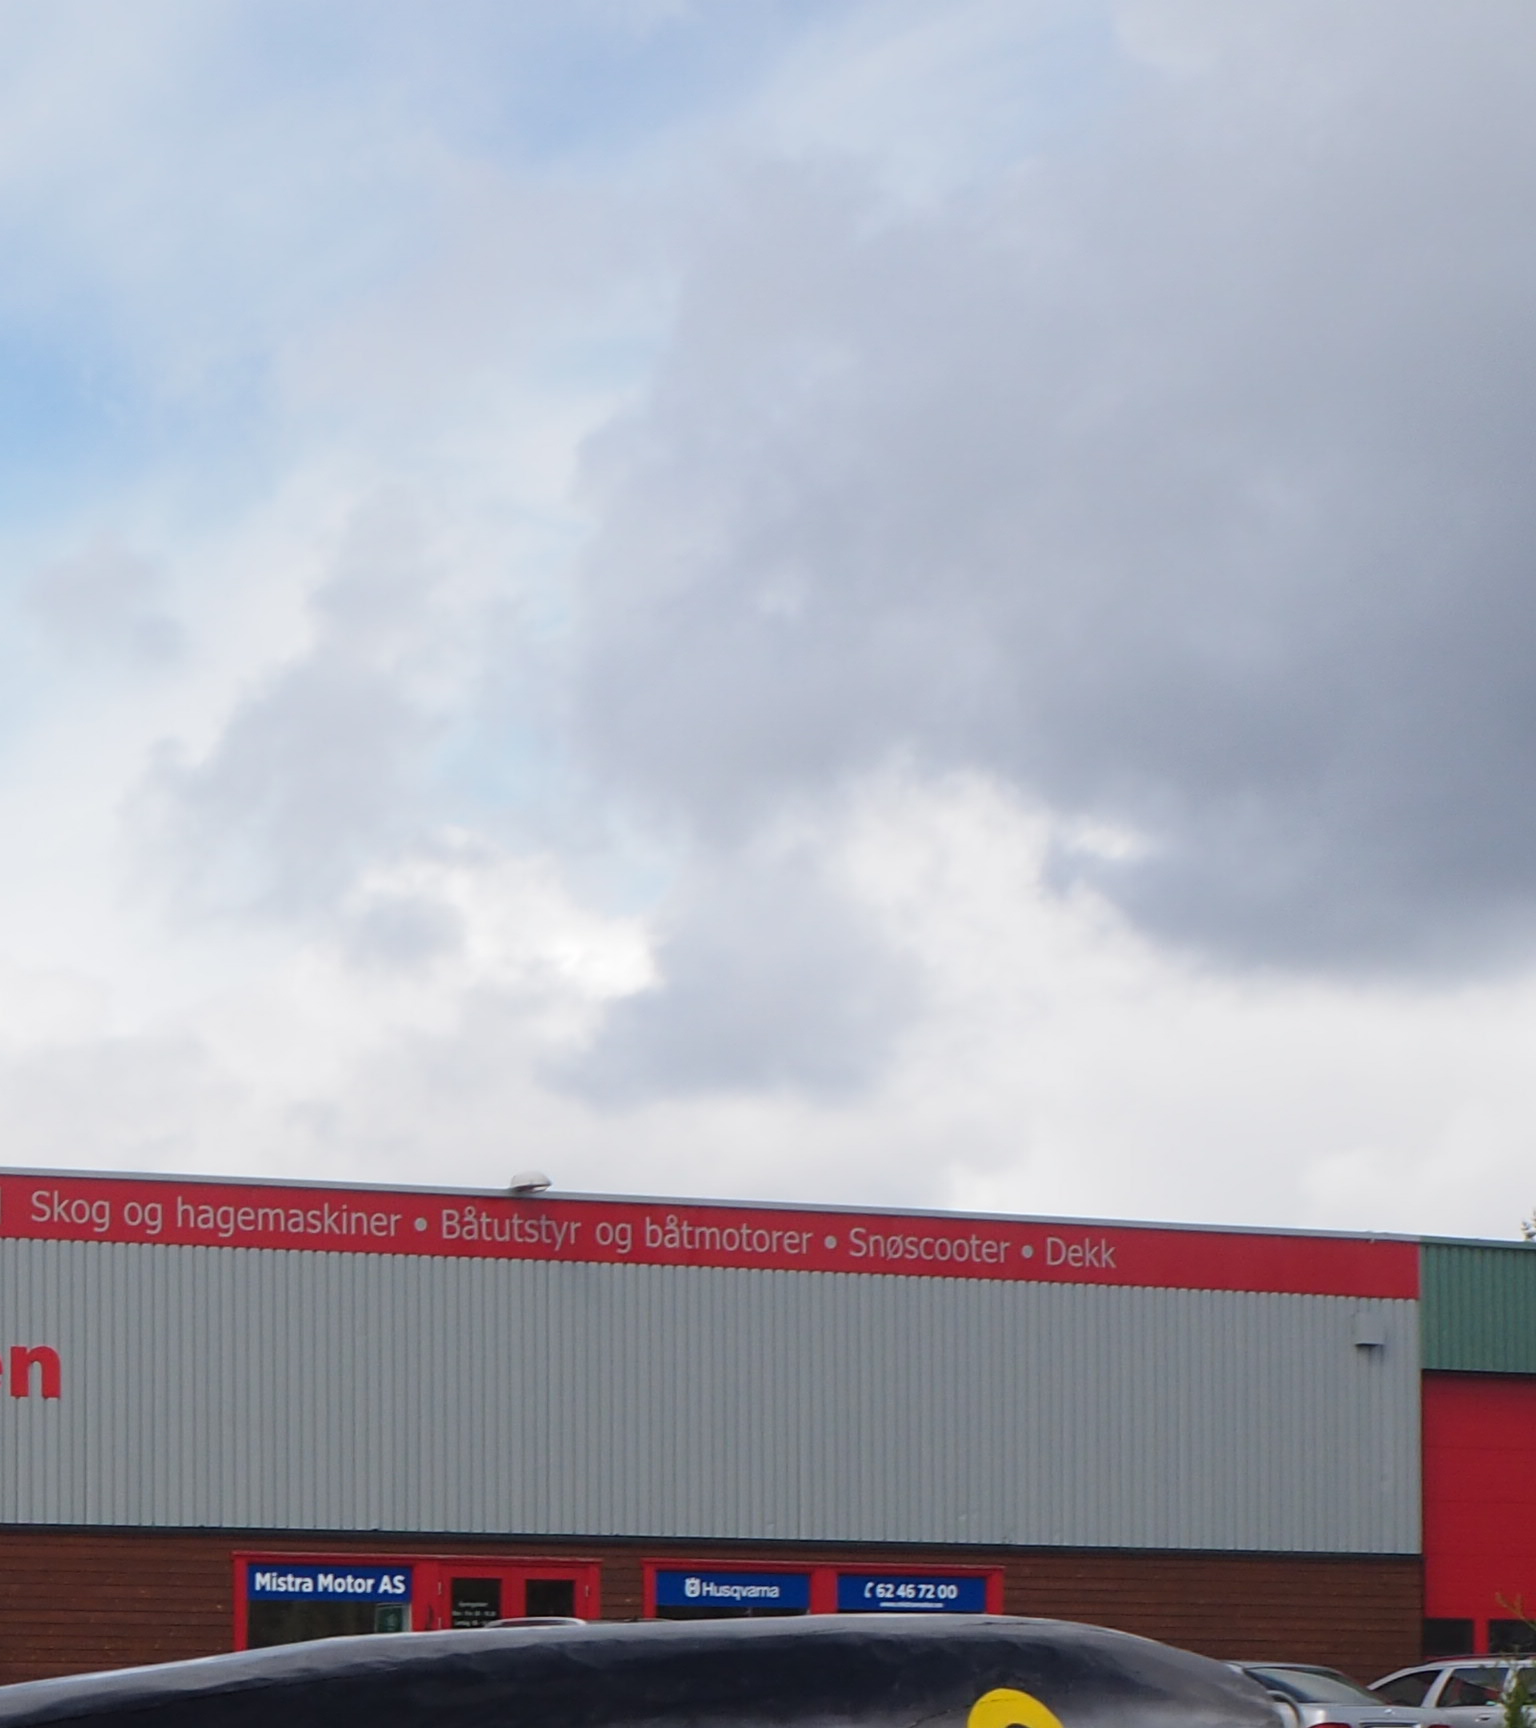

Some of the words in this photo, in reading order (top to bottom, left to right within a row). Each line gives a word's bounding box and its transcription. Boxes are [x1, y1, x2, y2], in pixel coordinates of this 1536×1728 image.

[30, 1190, 112, 1232] Skog
[123, 1200, 164, 1234] og
[176, 1196, 401, 1238] hagemaskiner
[441, 1208, 582, 1251] Båtutstyr
[595, 1220, 633, 1253] og
[645, 1214, 813, 1255] båtmotorer
[849, 1227, 1012, 1265] Snøscooter
[1045, 1236, 1117, 1269] Dekk
[254, 1572, 313, 1592] Mistra
[317, 1573, 375, 1593] Motor
[378, 1574, 406, 1594] AS
[701, 1582, 780, 1601] Husqvarna
[875, 1583, 895, 1599] 62
[896, 1584, 916, 1599] 46
[917, 1584, 936, 1599] 72
[937, 1584, 958, 1600] 00
